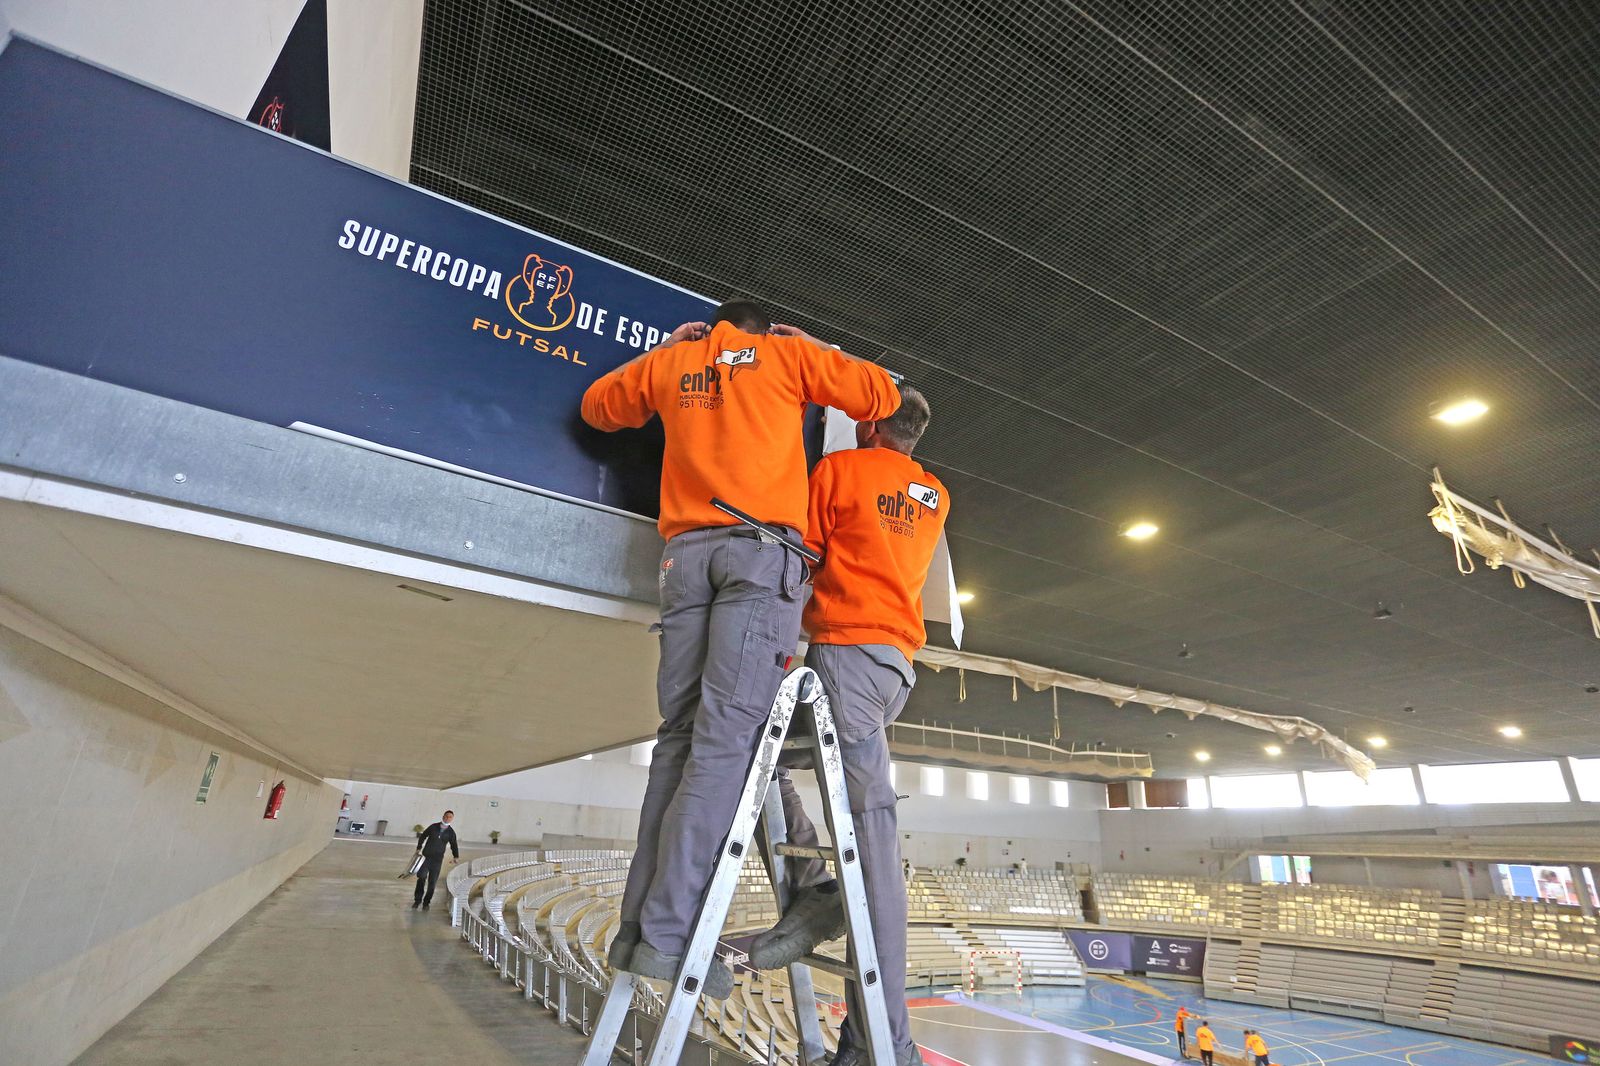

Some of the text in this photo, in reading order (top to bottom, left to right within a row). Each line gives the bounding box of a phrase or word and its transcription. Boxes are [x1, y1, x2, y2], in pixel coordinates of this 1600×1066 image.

[338, 219, 502, 300] SUPERCOPA
[576, 302, 608, 336] DE
[472, 317, 588, 367] FUTSAL
[680, 400, 694, 408] 951
[698, 400, 714, 410] 105
[877, 490, 915, 524] enPie
[890, 524, 902, 534] 105
